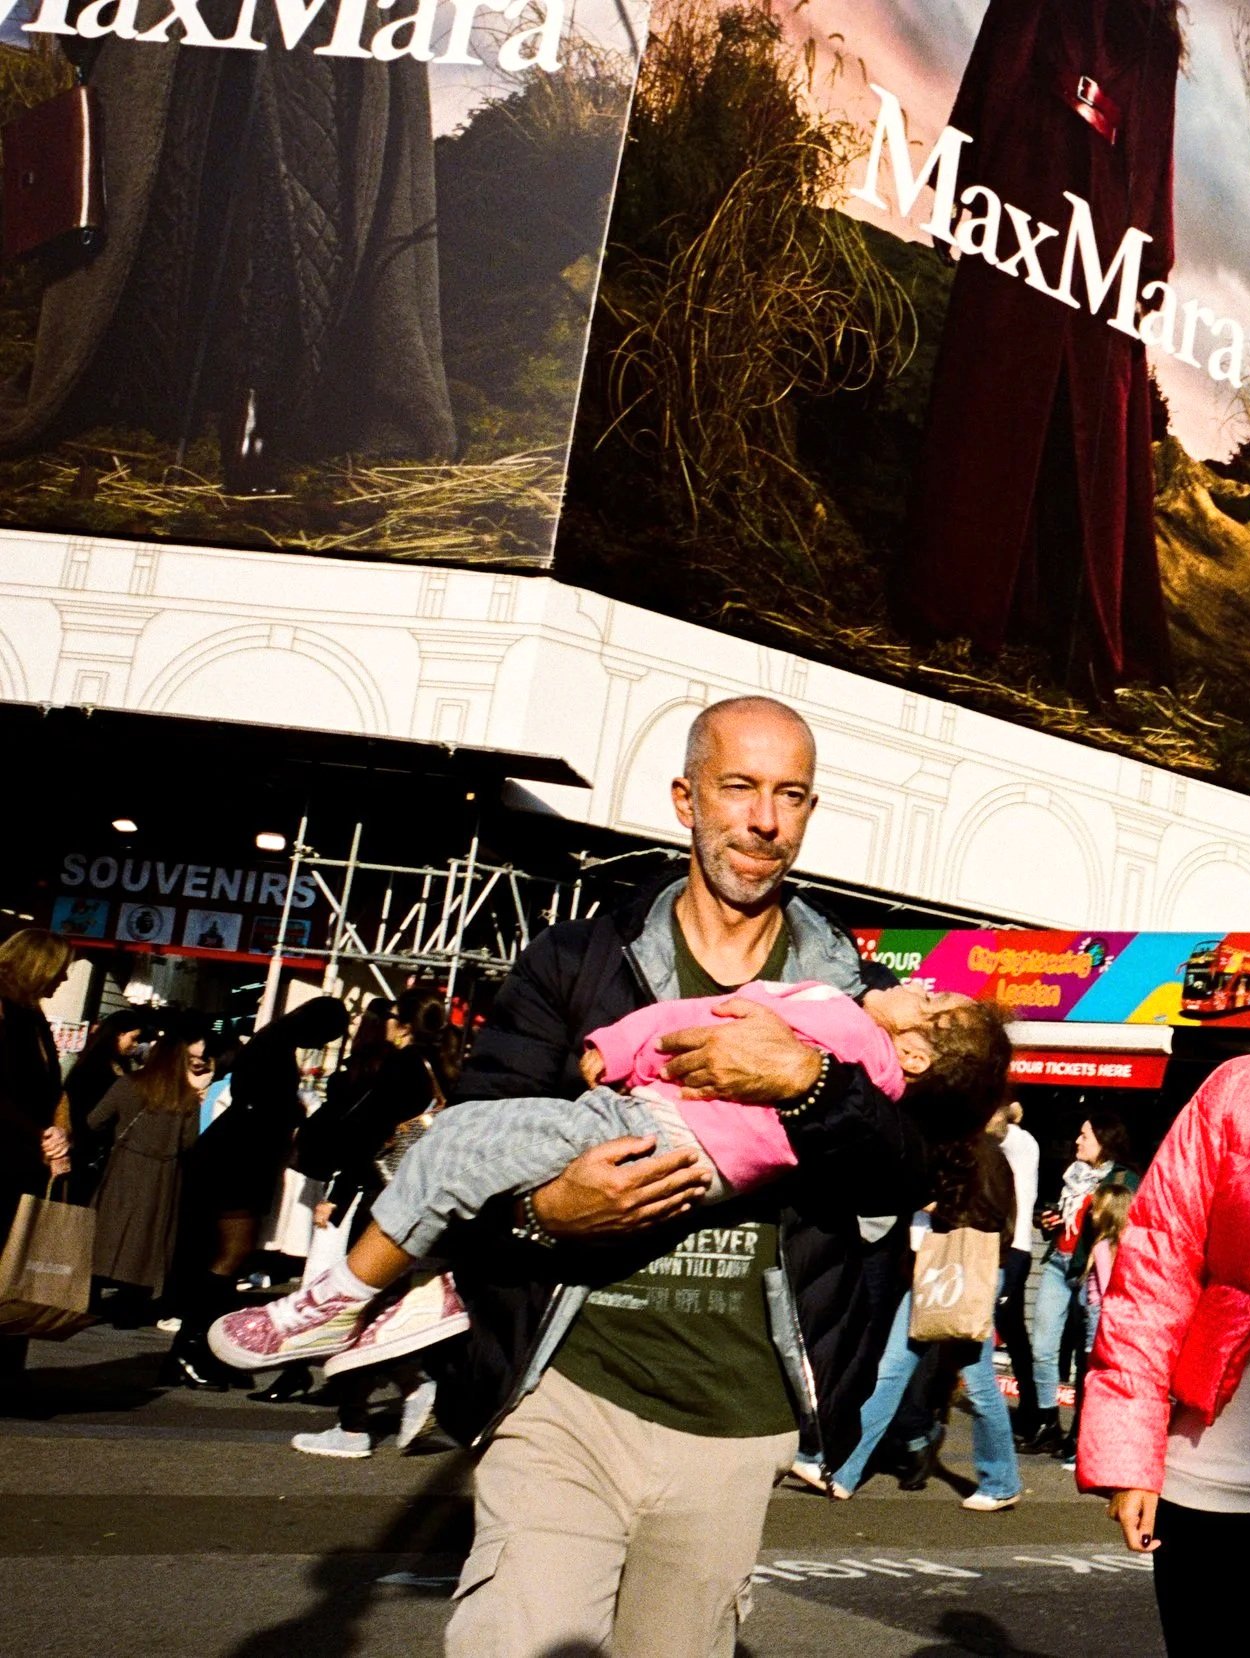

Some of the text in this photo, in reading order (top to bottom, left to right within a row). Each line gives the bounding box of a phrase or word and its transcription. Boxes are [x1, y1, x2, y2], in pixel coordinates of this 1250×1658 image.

[850, 83, 1243, 388] MaxMara
[60, 853, 316, 909] SOUVENIRS
[1009, 1060, 1132, 1078] YOUR TICKETS HERE
[676, 1229, 758, 1254] NEVER
[639, 1256, 682, 1277] OWN
[685, 1258, 713, 1278] TILL
